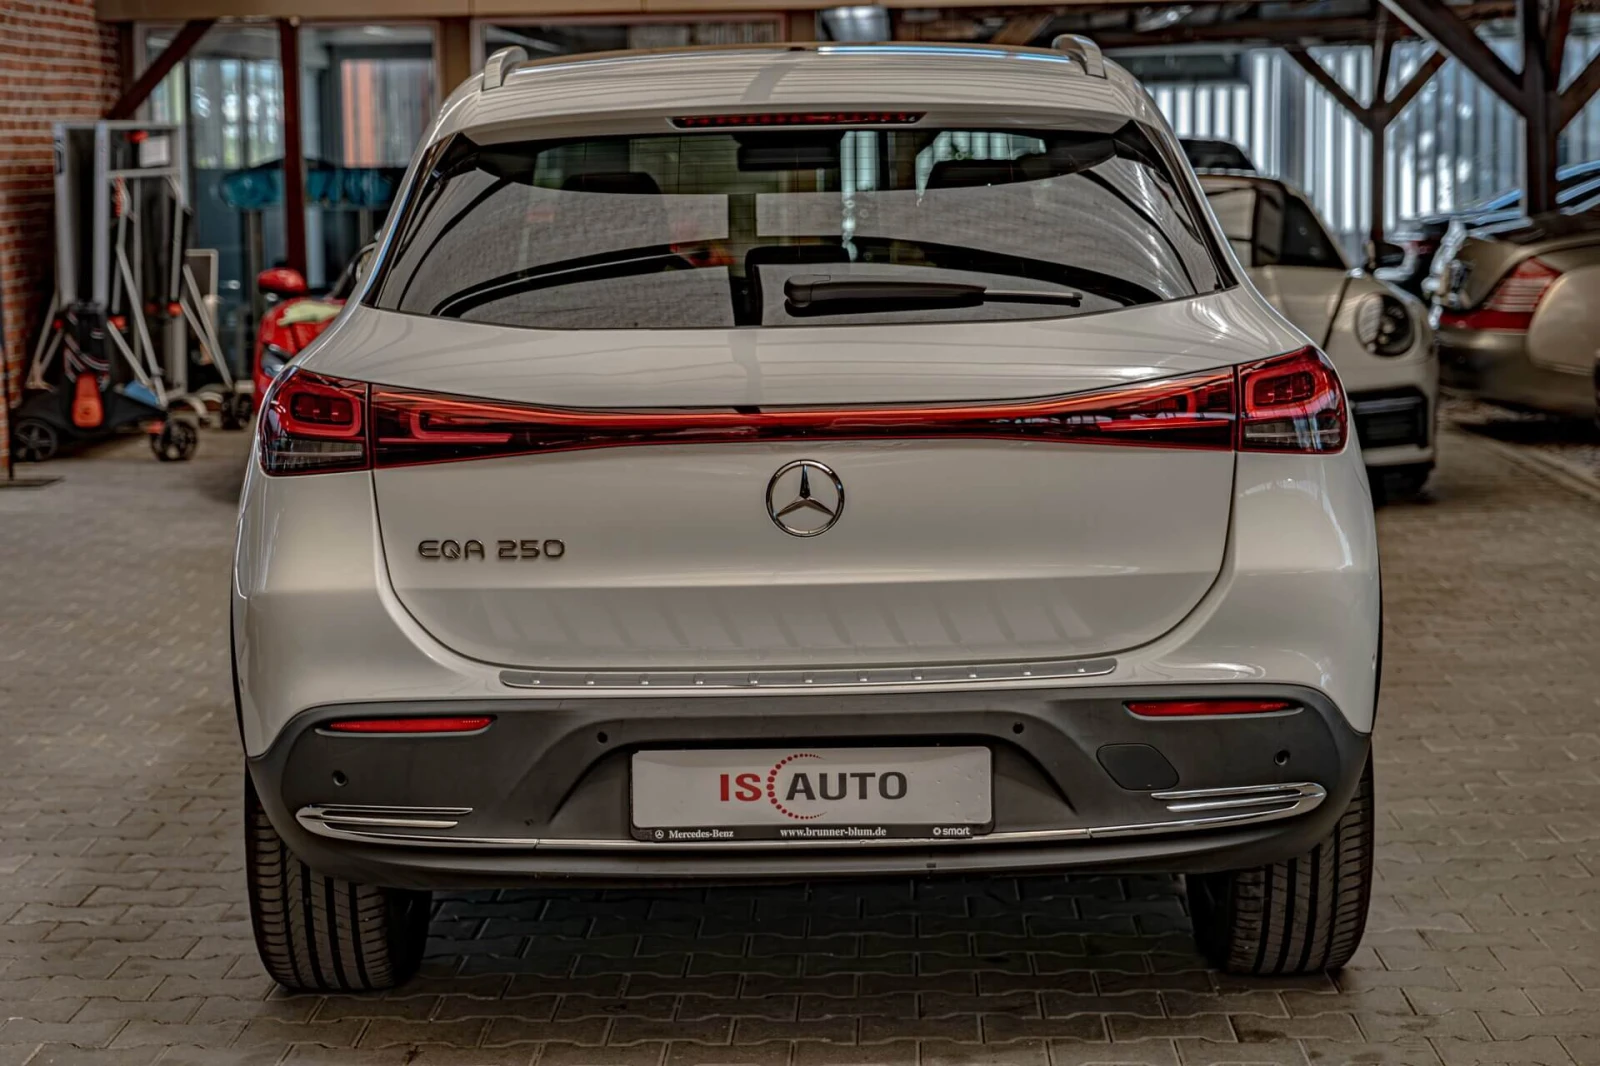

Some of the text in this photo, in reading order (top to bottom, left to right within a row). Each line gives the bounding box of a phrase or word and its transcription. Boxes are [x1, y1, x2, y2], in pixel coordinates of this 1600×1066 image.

[418, 539, 565, 560] EQA 250
[719, 771, 907, 802] IS AUTO
[668, 830, 734, 839] Mercedes-Benz
[780, 827, 887, 837] www.brunner-blum.de
[942, 827, 970, 836] smart
